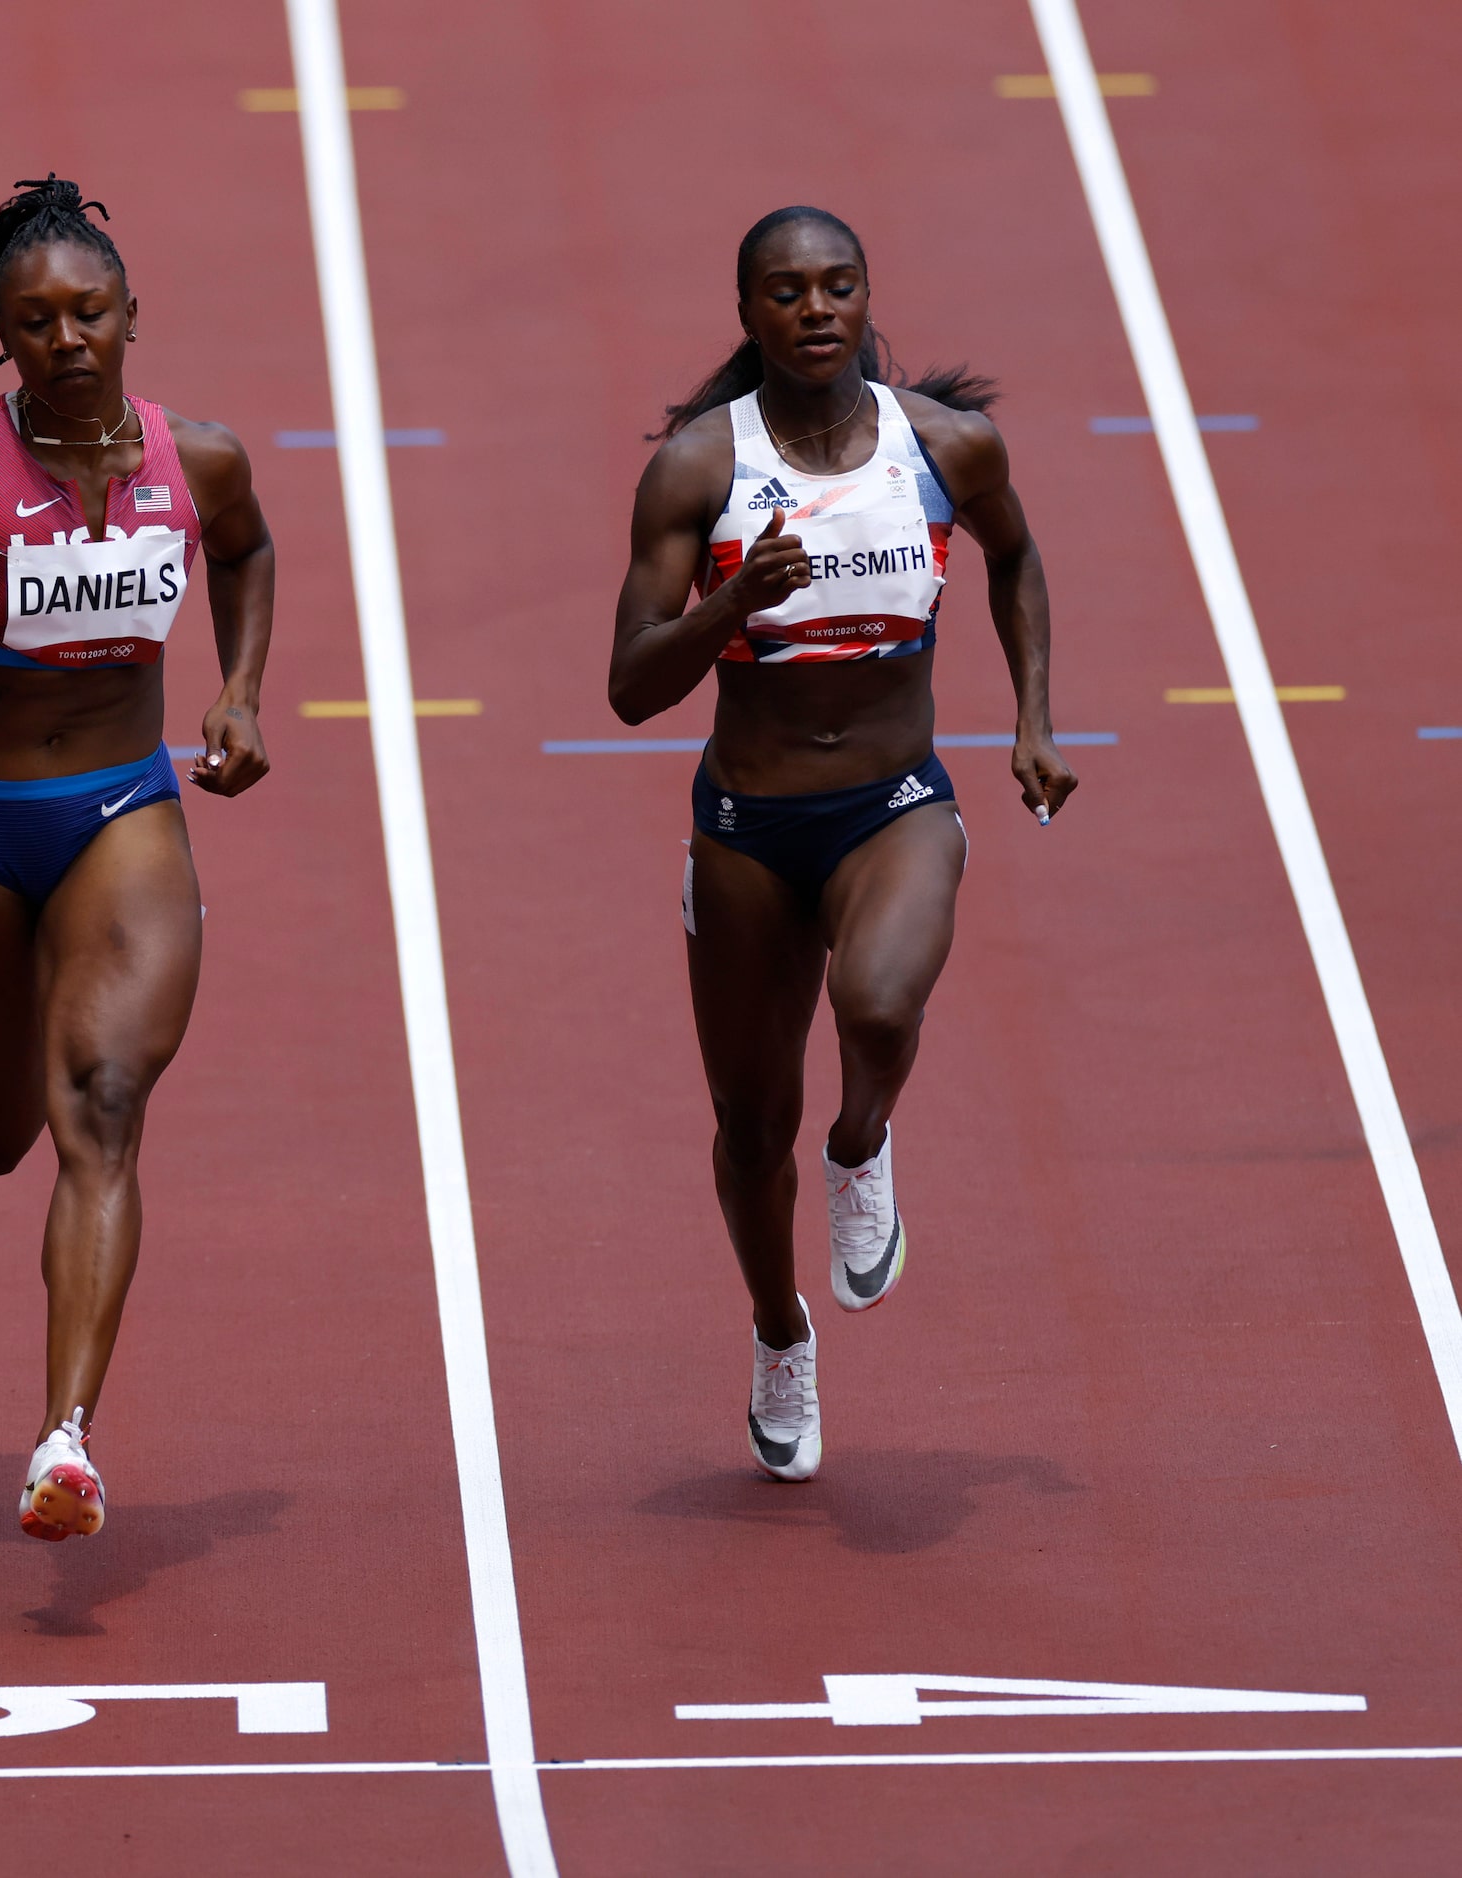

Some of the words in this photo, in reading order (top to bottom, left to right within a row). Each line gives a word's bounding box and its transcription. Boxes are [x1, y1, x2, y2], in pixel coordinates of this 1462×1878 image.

[809, 544, 926, 580] ER-SMITH
[20, 562, 178, 616] DANIELS
[805, 628, 834, 638] TOKYO
[835, 626, 856, 636] 2020
[59, 651, 87, 659] TOKYO
[88, 648, 108, 659] 2020
[888, 786, 934, 808] adidas
[674, 1673, 1368, 1726] 4
